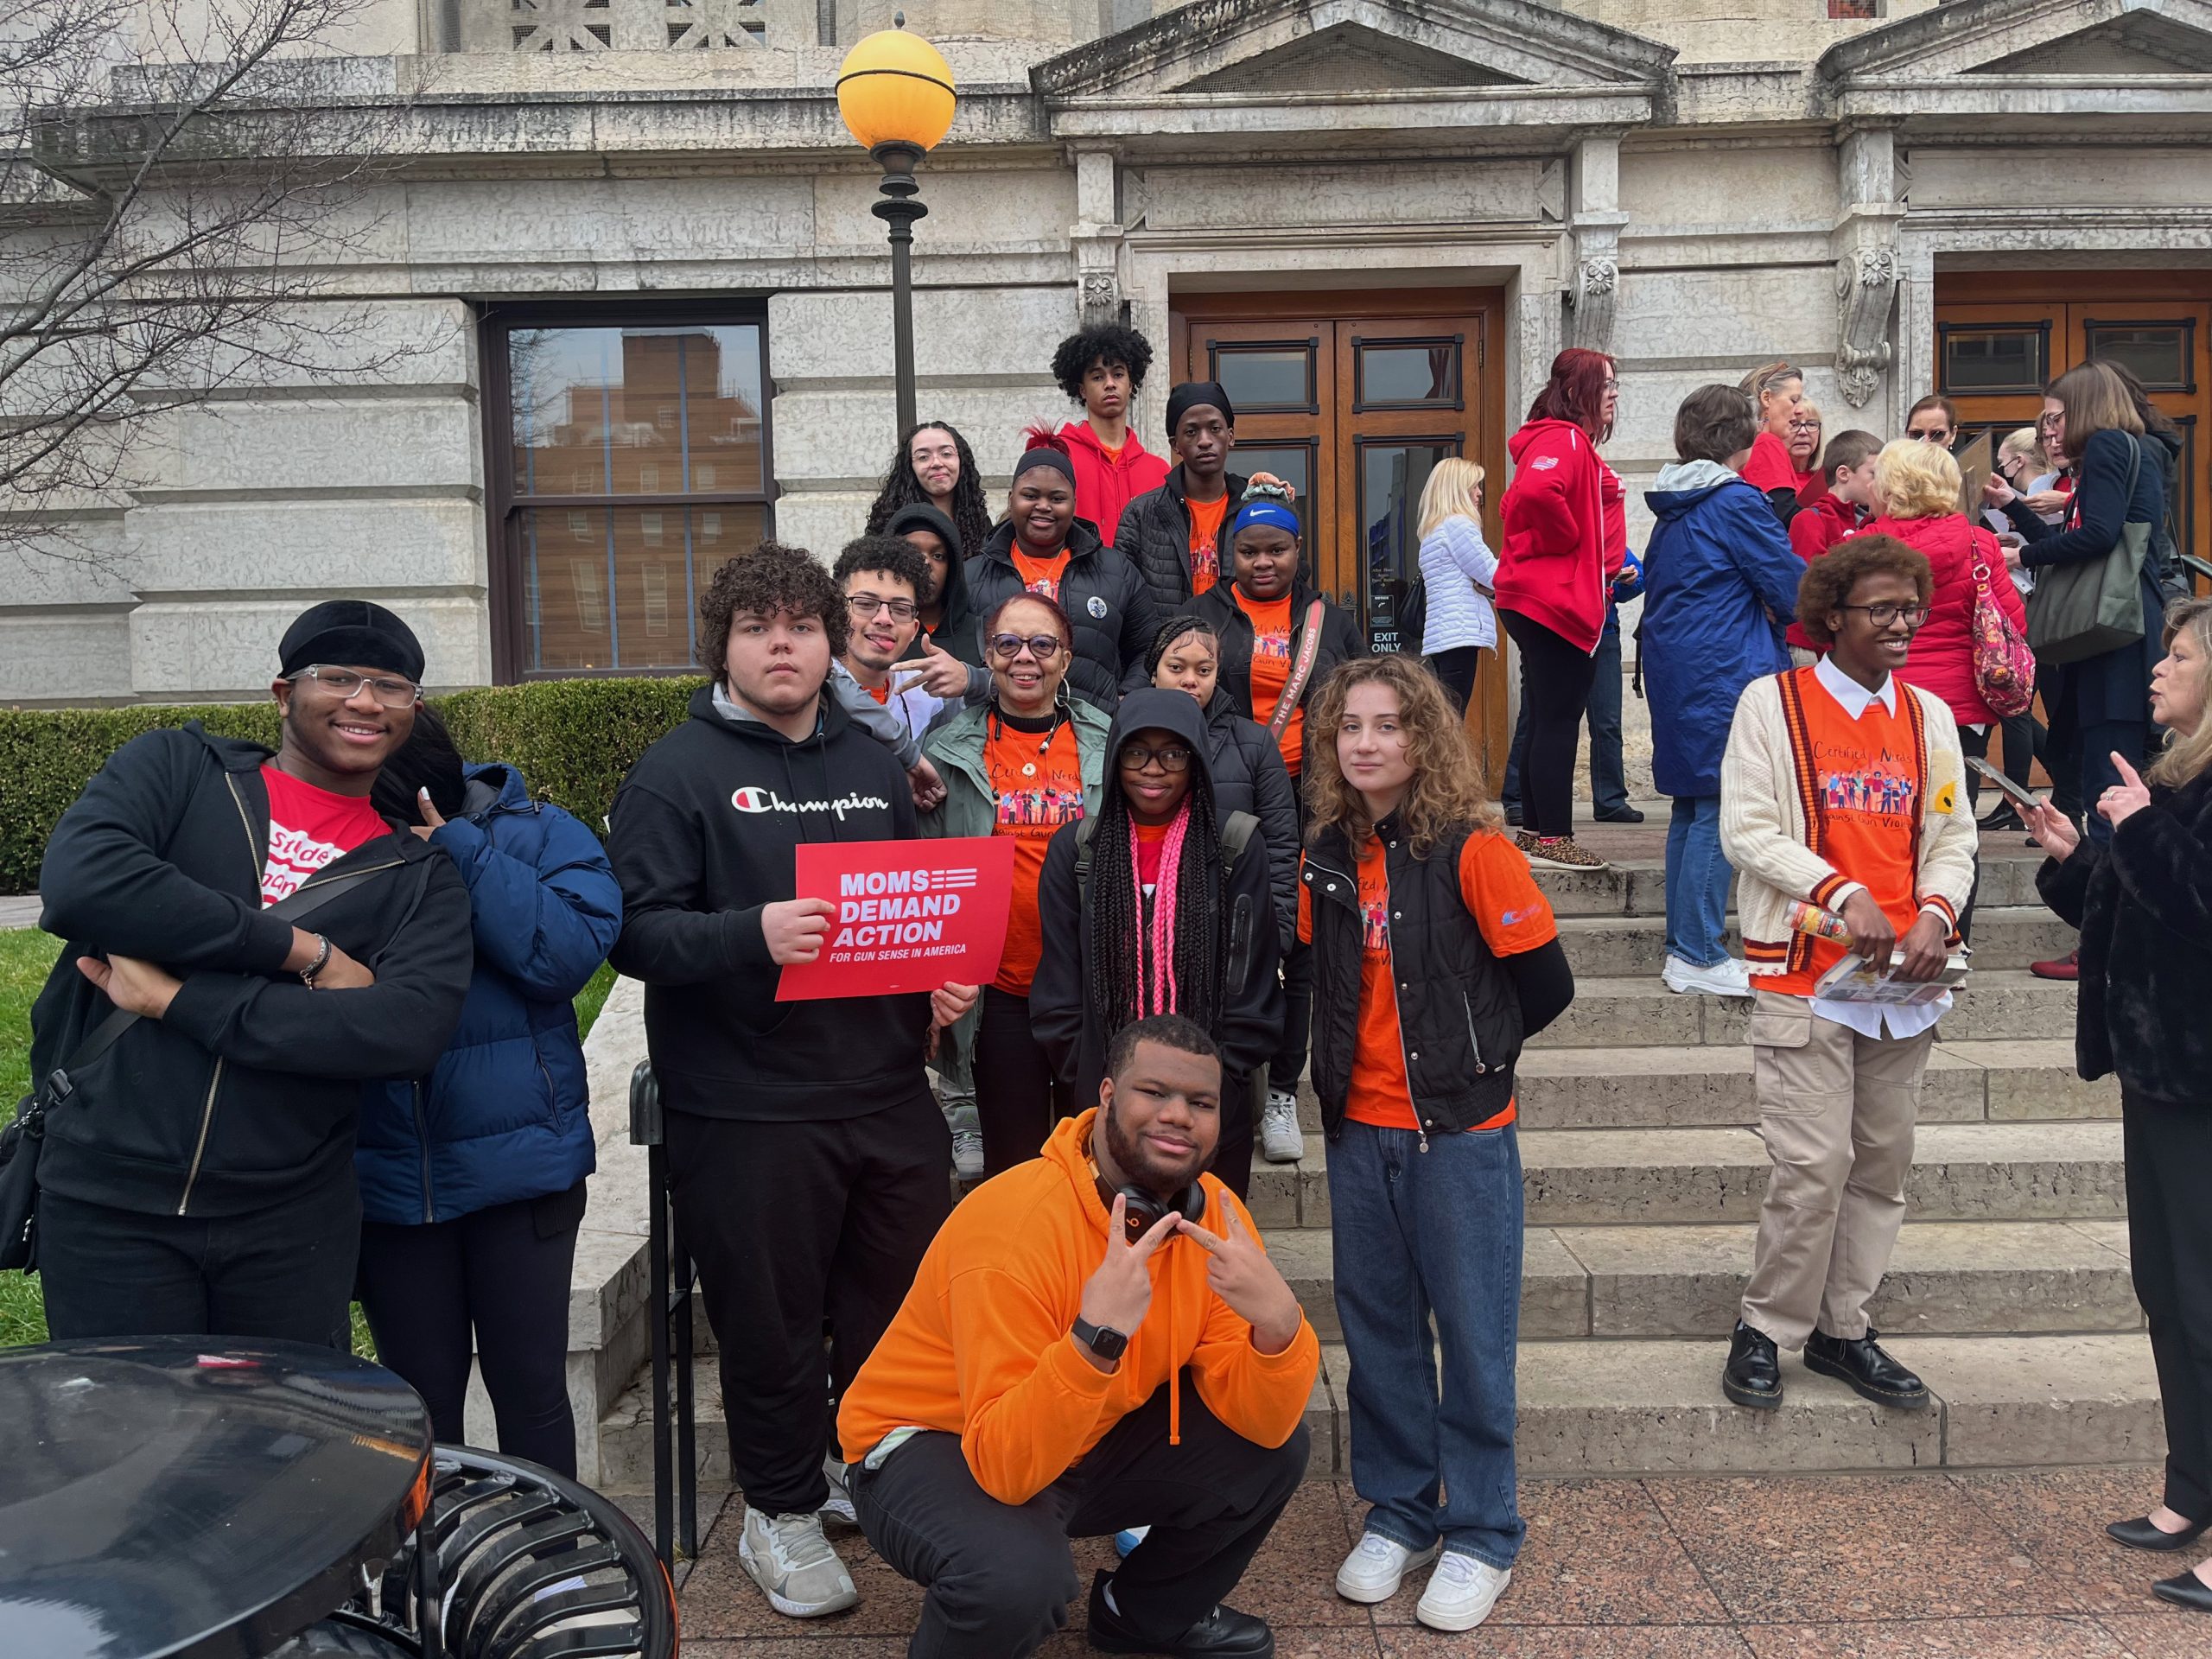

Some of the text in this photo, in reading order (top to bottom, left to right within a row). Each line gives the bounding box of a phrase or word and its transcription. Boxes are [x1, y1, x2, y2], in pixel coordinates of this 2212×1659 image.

[1371, 642, 1401, 652] ONLY
[1374, 632, 1398, 642] EXIT
[1274, 628, 1316, 725] THE MARC JACOBS
[1814, 741, 1867, 760] Certified
[731, 786, 889, 822] Champion
[841, 870, 929, 897] MOMS
[839, 893, 961, 924] DEMAND
[832, 920, 943, 948] ACTION
[830, 944, 967, 963] FOR GUN SENSE IN AMERICA
